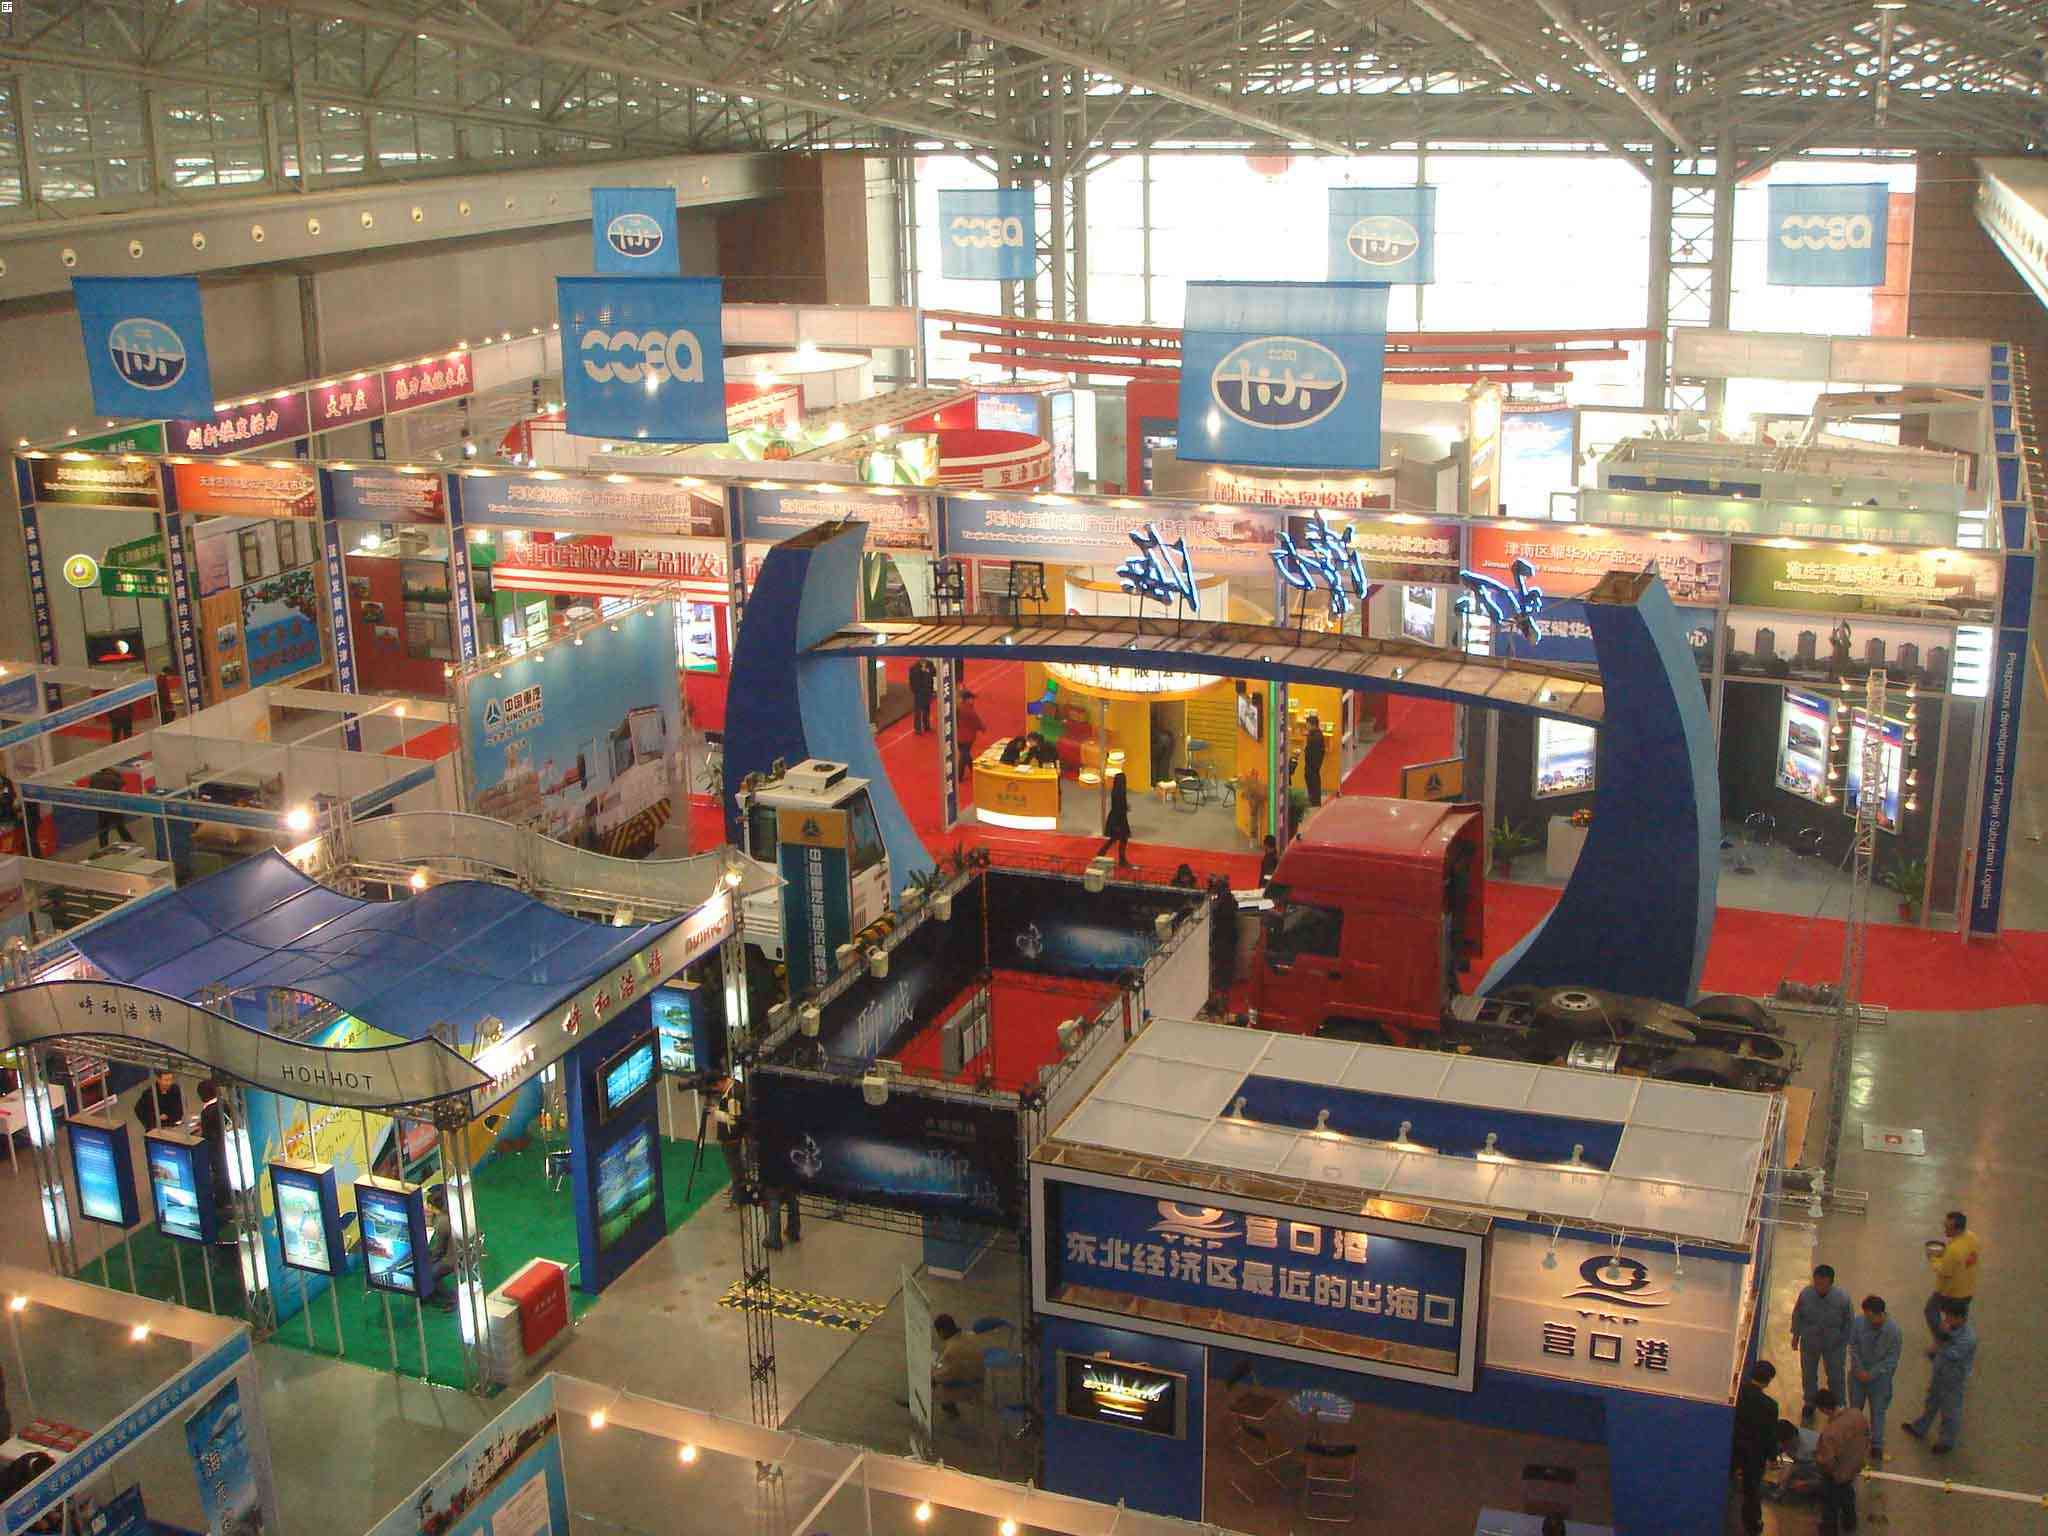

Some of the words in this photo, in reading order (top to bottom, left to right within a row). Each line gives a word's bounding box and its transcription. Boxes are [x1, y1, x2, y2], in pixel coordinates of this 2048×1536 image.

[77, 996, 163, 1024] 呼和浩特
[282, 1064, 375, 1091] HOHHOT
[1066, 1231, 1455, 1327] 东北经济区最近的出海口
[1543, 1320, 1670, 1372] 营口港
